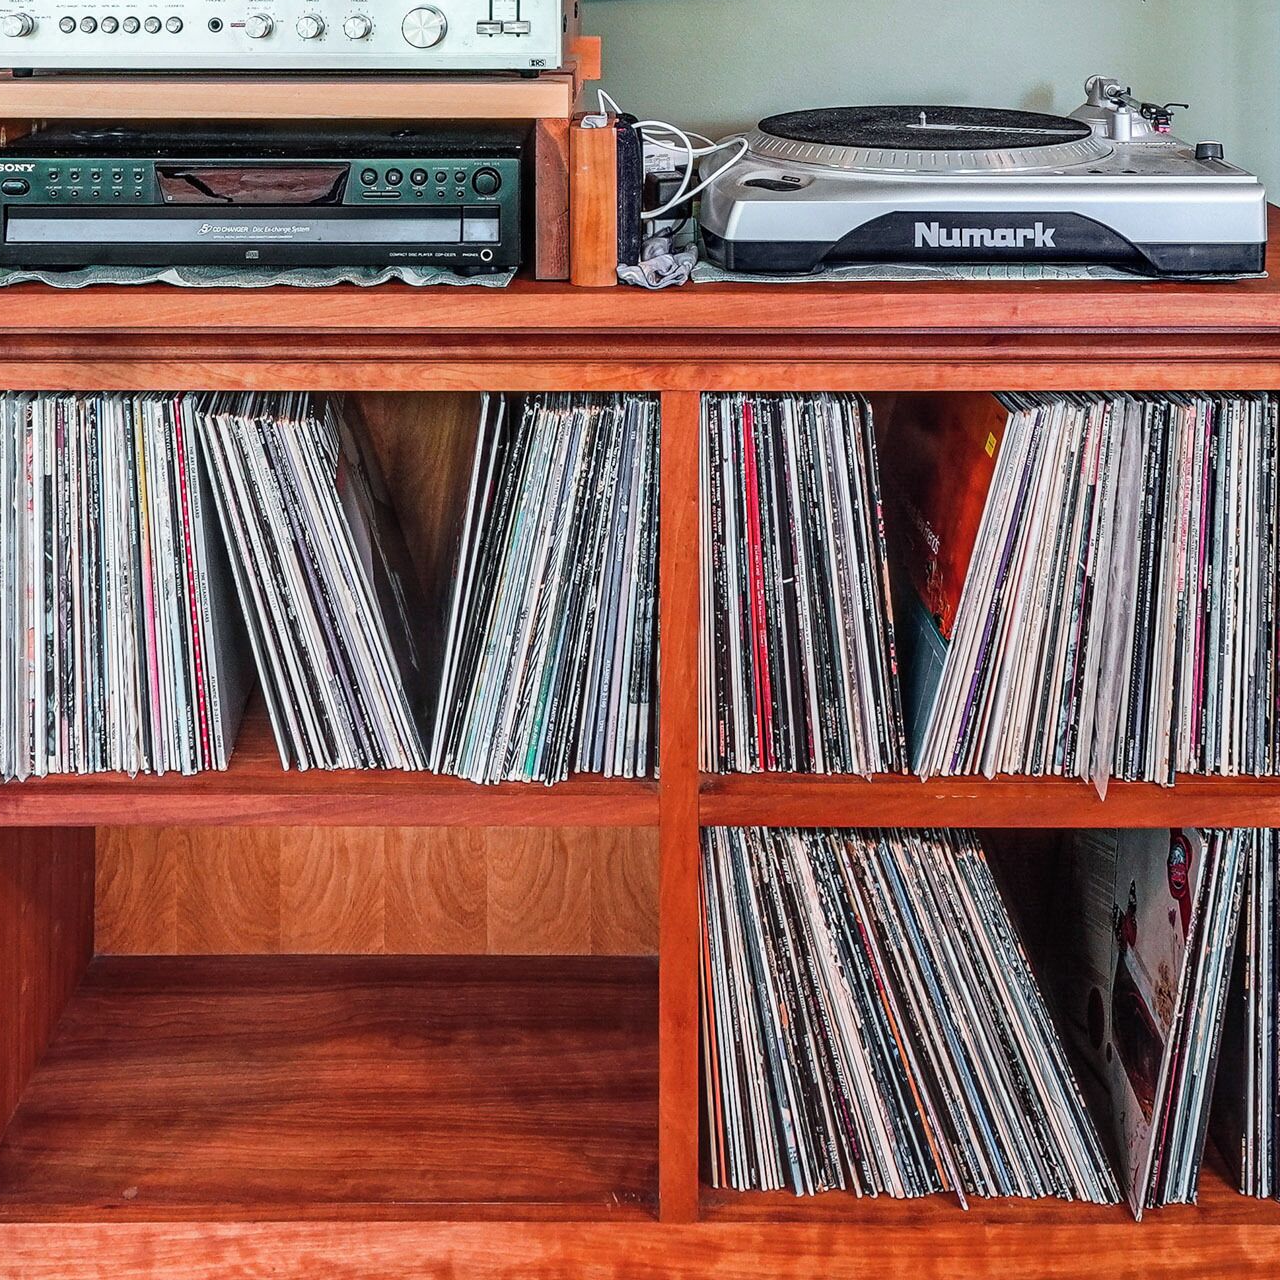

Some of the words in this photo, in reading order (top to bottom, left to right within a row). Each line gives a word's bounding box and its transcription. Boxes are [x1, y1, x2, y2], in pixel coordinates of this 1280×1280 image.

[291, 226, 310, 234] System
[914, 222, 1056, 248] Numark
[603, 660, 611, 683] ATLANTIC
[549, 698, 558, 722] ATLANTIC
[806, 955, 819, 987] TERMINAL
[815, 987, 825, 1009] TOWER
[822, 1015, 829, 1025] AN
[825, 1026, 838, 1058] ARCHIVAL
[834, 1059, 849, 1099] COLLECTION
